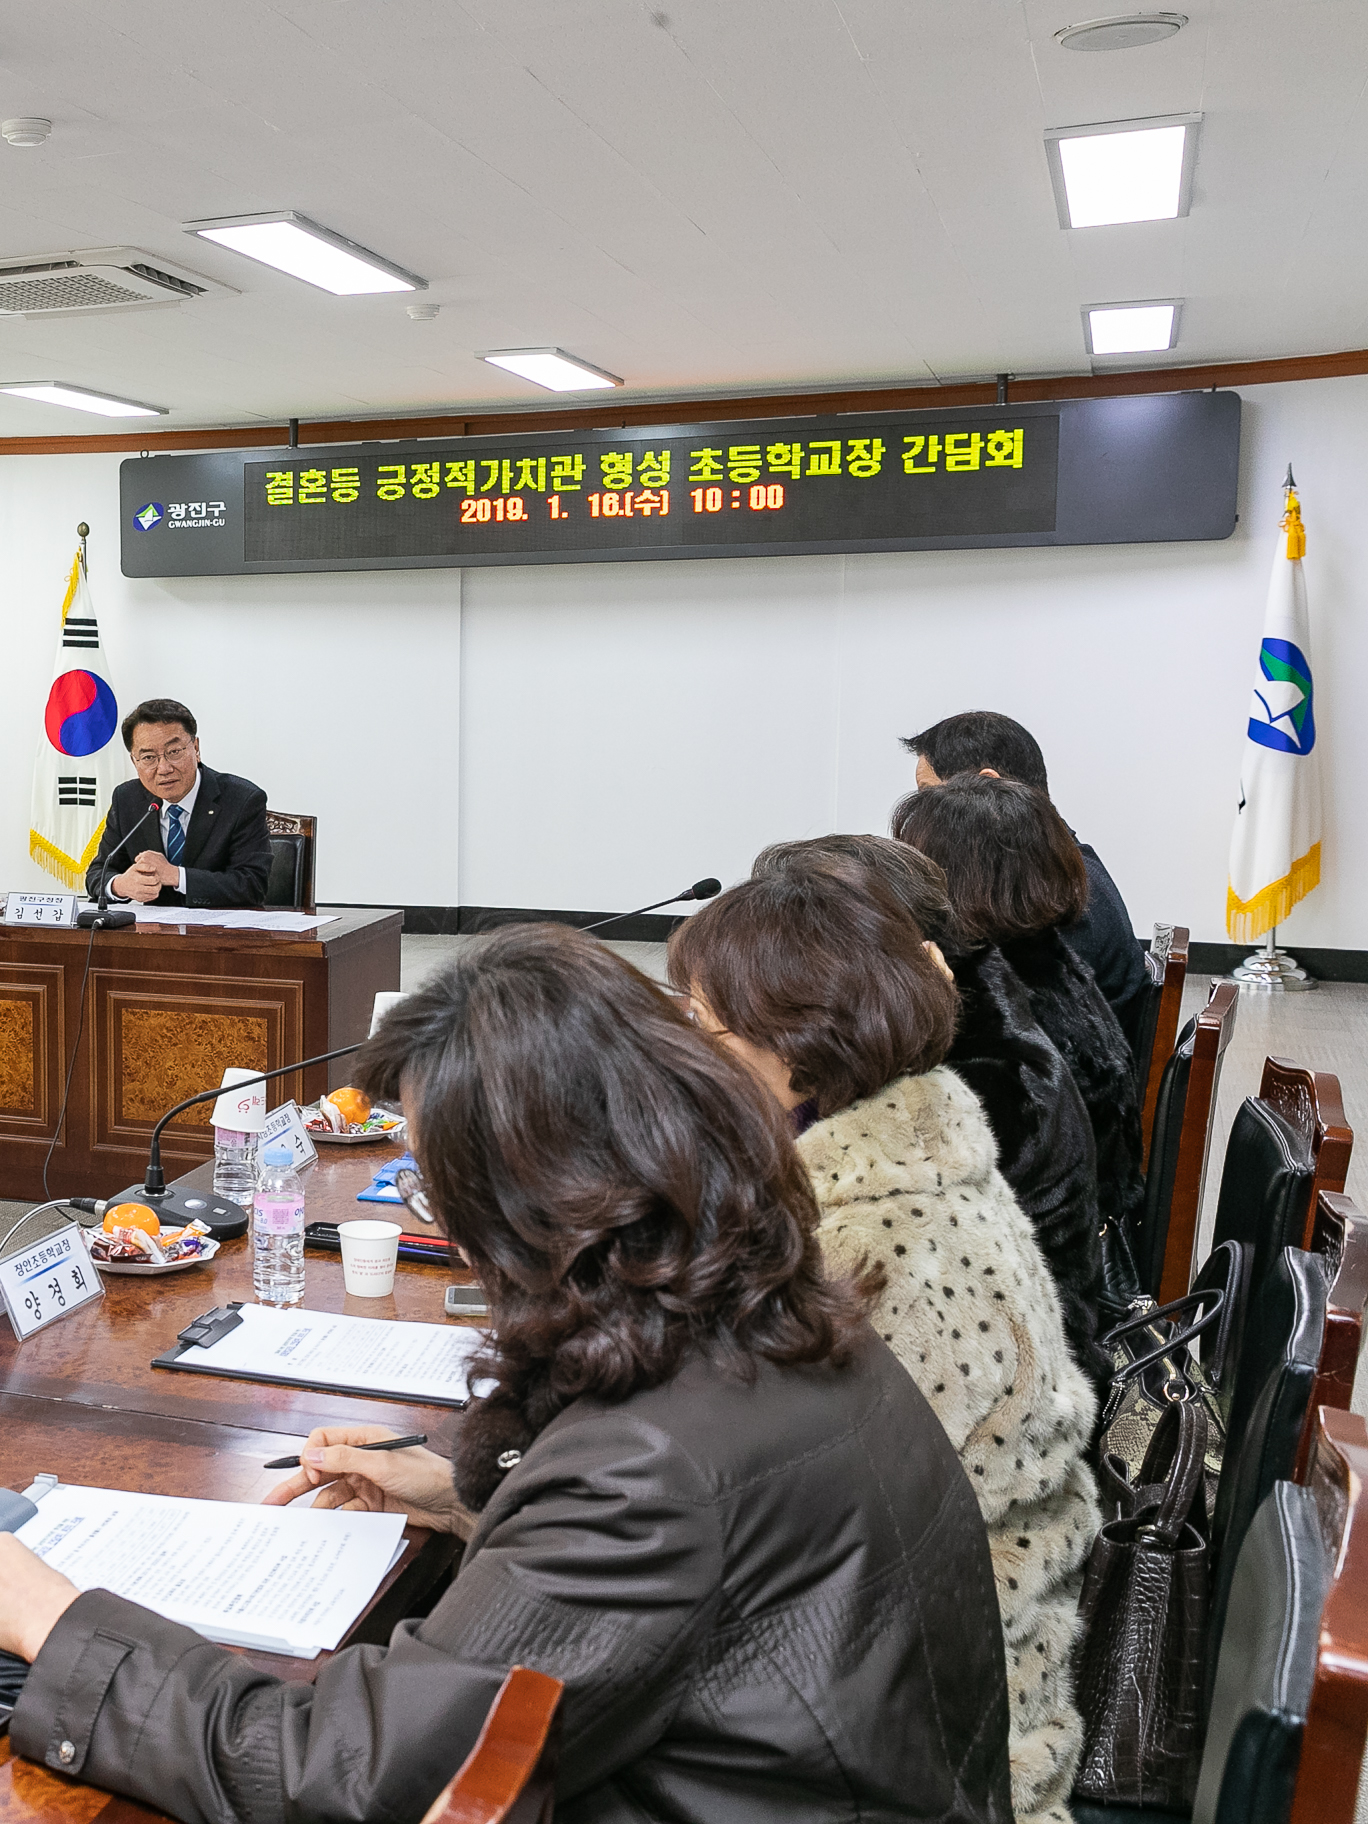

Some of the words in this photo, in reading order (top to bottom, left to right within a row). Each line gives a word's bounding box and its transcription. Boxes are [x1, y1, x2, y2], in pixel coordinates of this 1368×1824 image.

[264, 467, 362, 507] 결혼등
[376, 453, 586, 501] 긍정적가치관
[600, 449, 672, 491] 형성
[688, 438, 887, 485] 초등학교장
[901, 428, 1024, 475] 간담회
[167, 501, 226, 519] 광진구
[168, 518, 225, 528] GWANGJIN-GU
[460, 496, 529, 523] 2019.
[547, 494, 569, 519] 1.
[13, 1238, 72, 1277] 장안초등학교장
